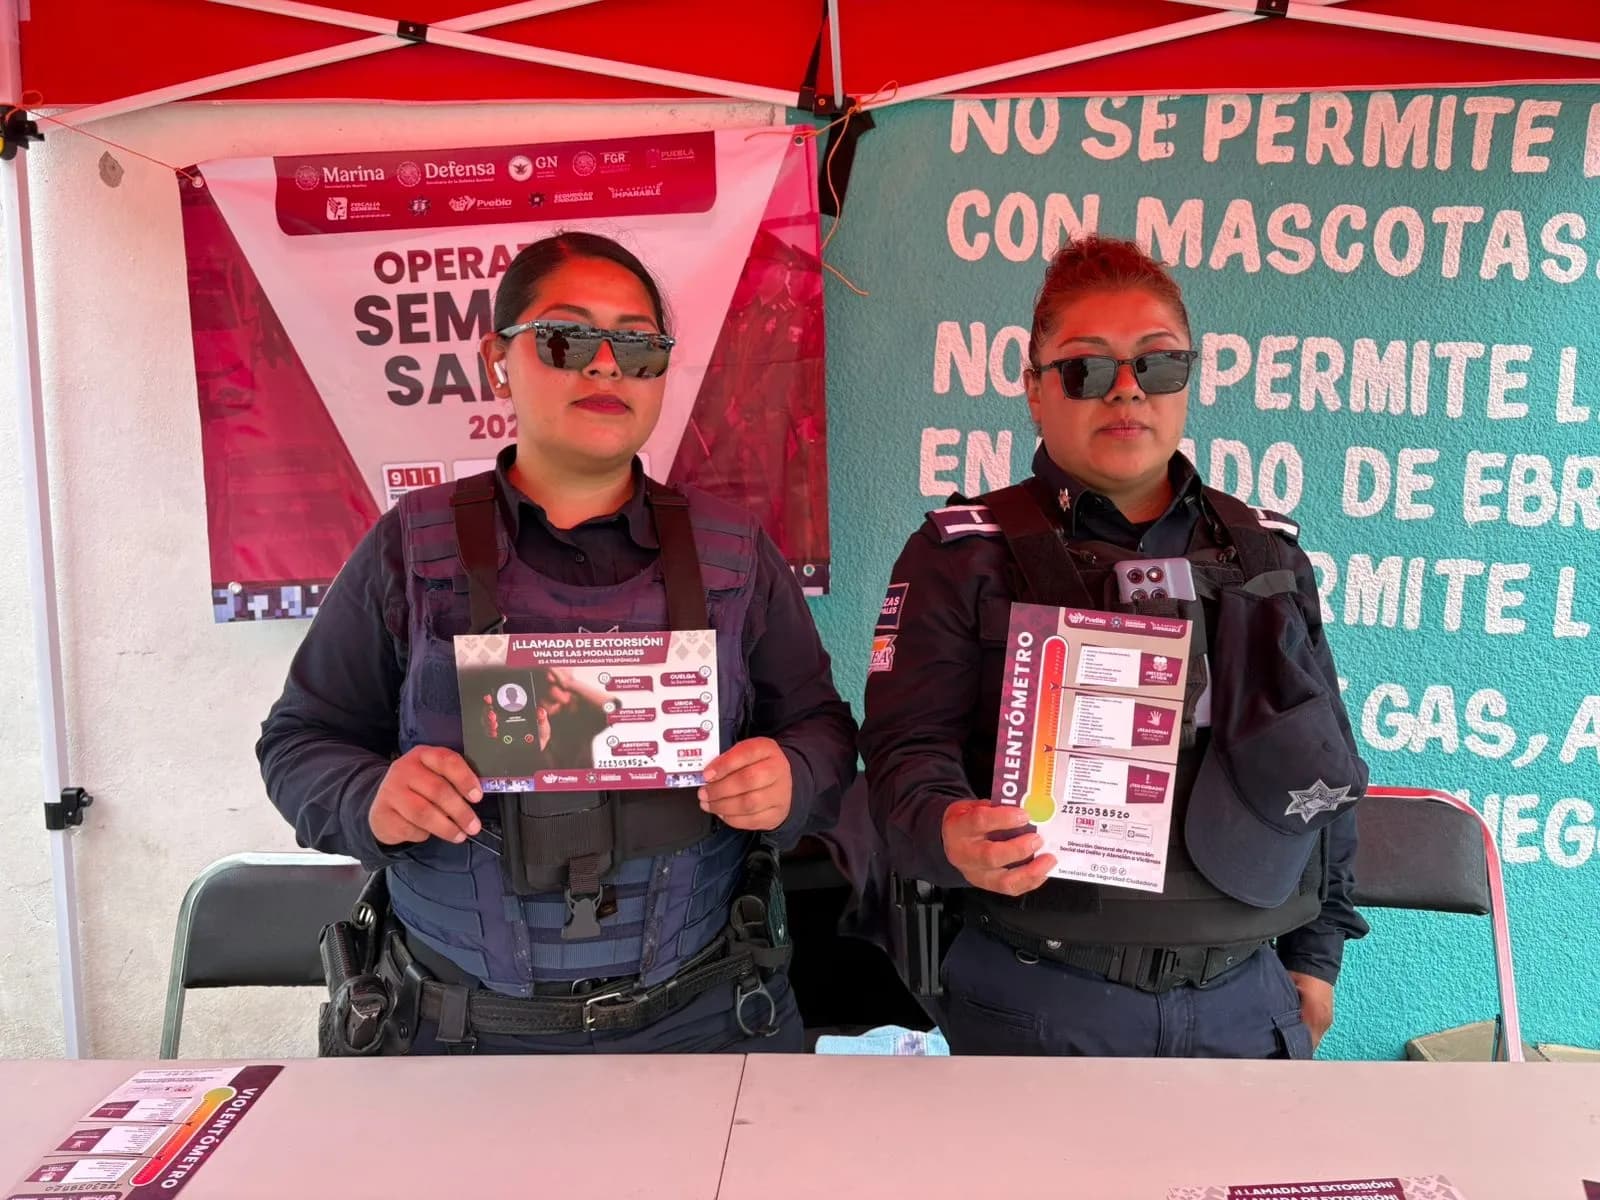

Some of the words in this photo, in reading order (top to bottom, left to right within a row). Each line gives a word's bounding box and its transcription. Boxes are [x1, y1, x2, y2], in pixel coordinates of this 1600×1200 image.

[950, 96, 1060, 155] NO
[1081, 95, 1181, 161] SE
[1202, 92, 1562, 173] PERMITE
[322, 165, 385, 183] Marina
[424, 161, 496, 179] Defensa
[535, 155, 559, 168] GN
[604, 153, 626, 164] FGR
[947, 189, 1100, 262] CON
[373, 244, 537, 284] OPERA
[354, 289, 491, 346] SEM
[933, 321, 1032, 397] NO
[1199, 332, 1533, 420] PERMITE
[468, 414, 518, 440] 202
[391, 469, 436, 486] 911
[919, 427, 1013, 499] EN
[1343, 446, 1440, 520] DE
[1305, 551, 1531, 635] RMITE
[512, 638, 575, 651] ¡LLAMADA
[576, 638, 593, 648] DE
[594, 635, 664, 648] EXTORSIÓN!
[533, 650, 553, 658] UNA
[583, 649, 644, 657] MODALIDADES
[1001, 631, 1034, 806] IOLENTÓMETRO
[1360, 683, 1549, 768] GAS,
[1061, 805, 1130, 819] 2223038520
[160, 1087, 259, 1189] VIOLENTÓMETRO
[1301, 1184, 1318, 1194] DE
[1319, 1181, 1396, 1193] EXTORSIÓN!
